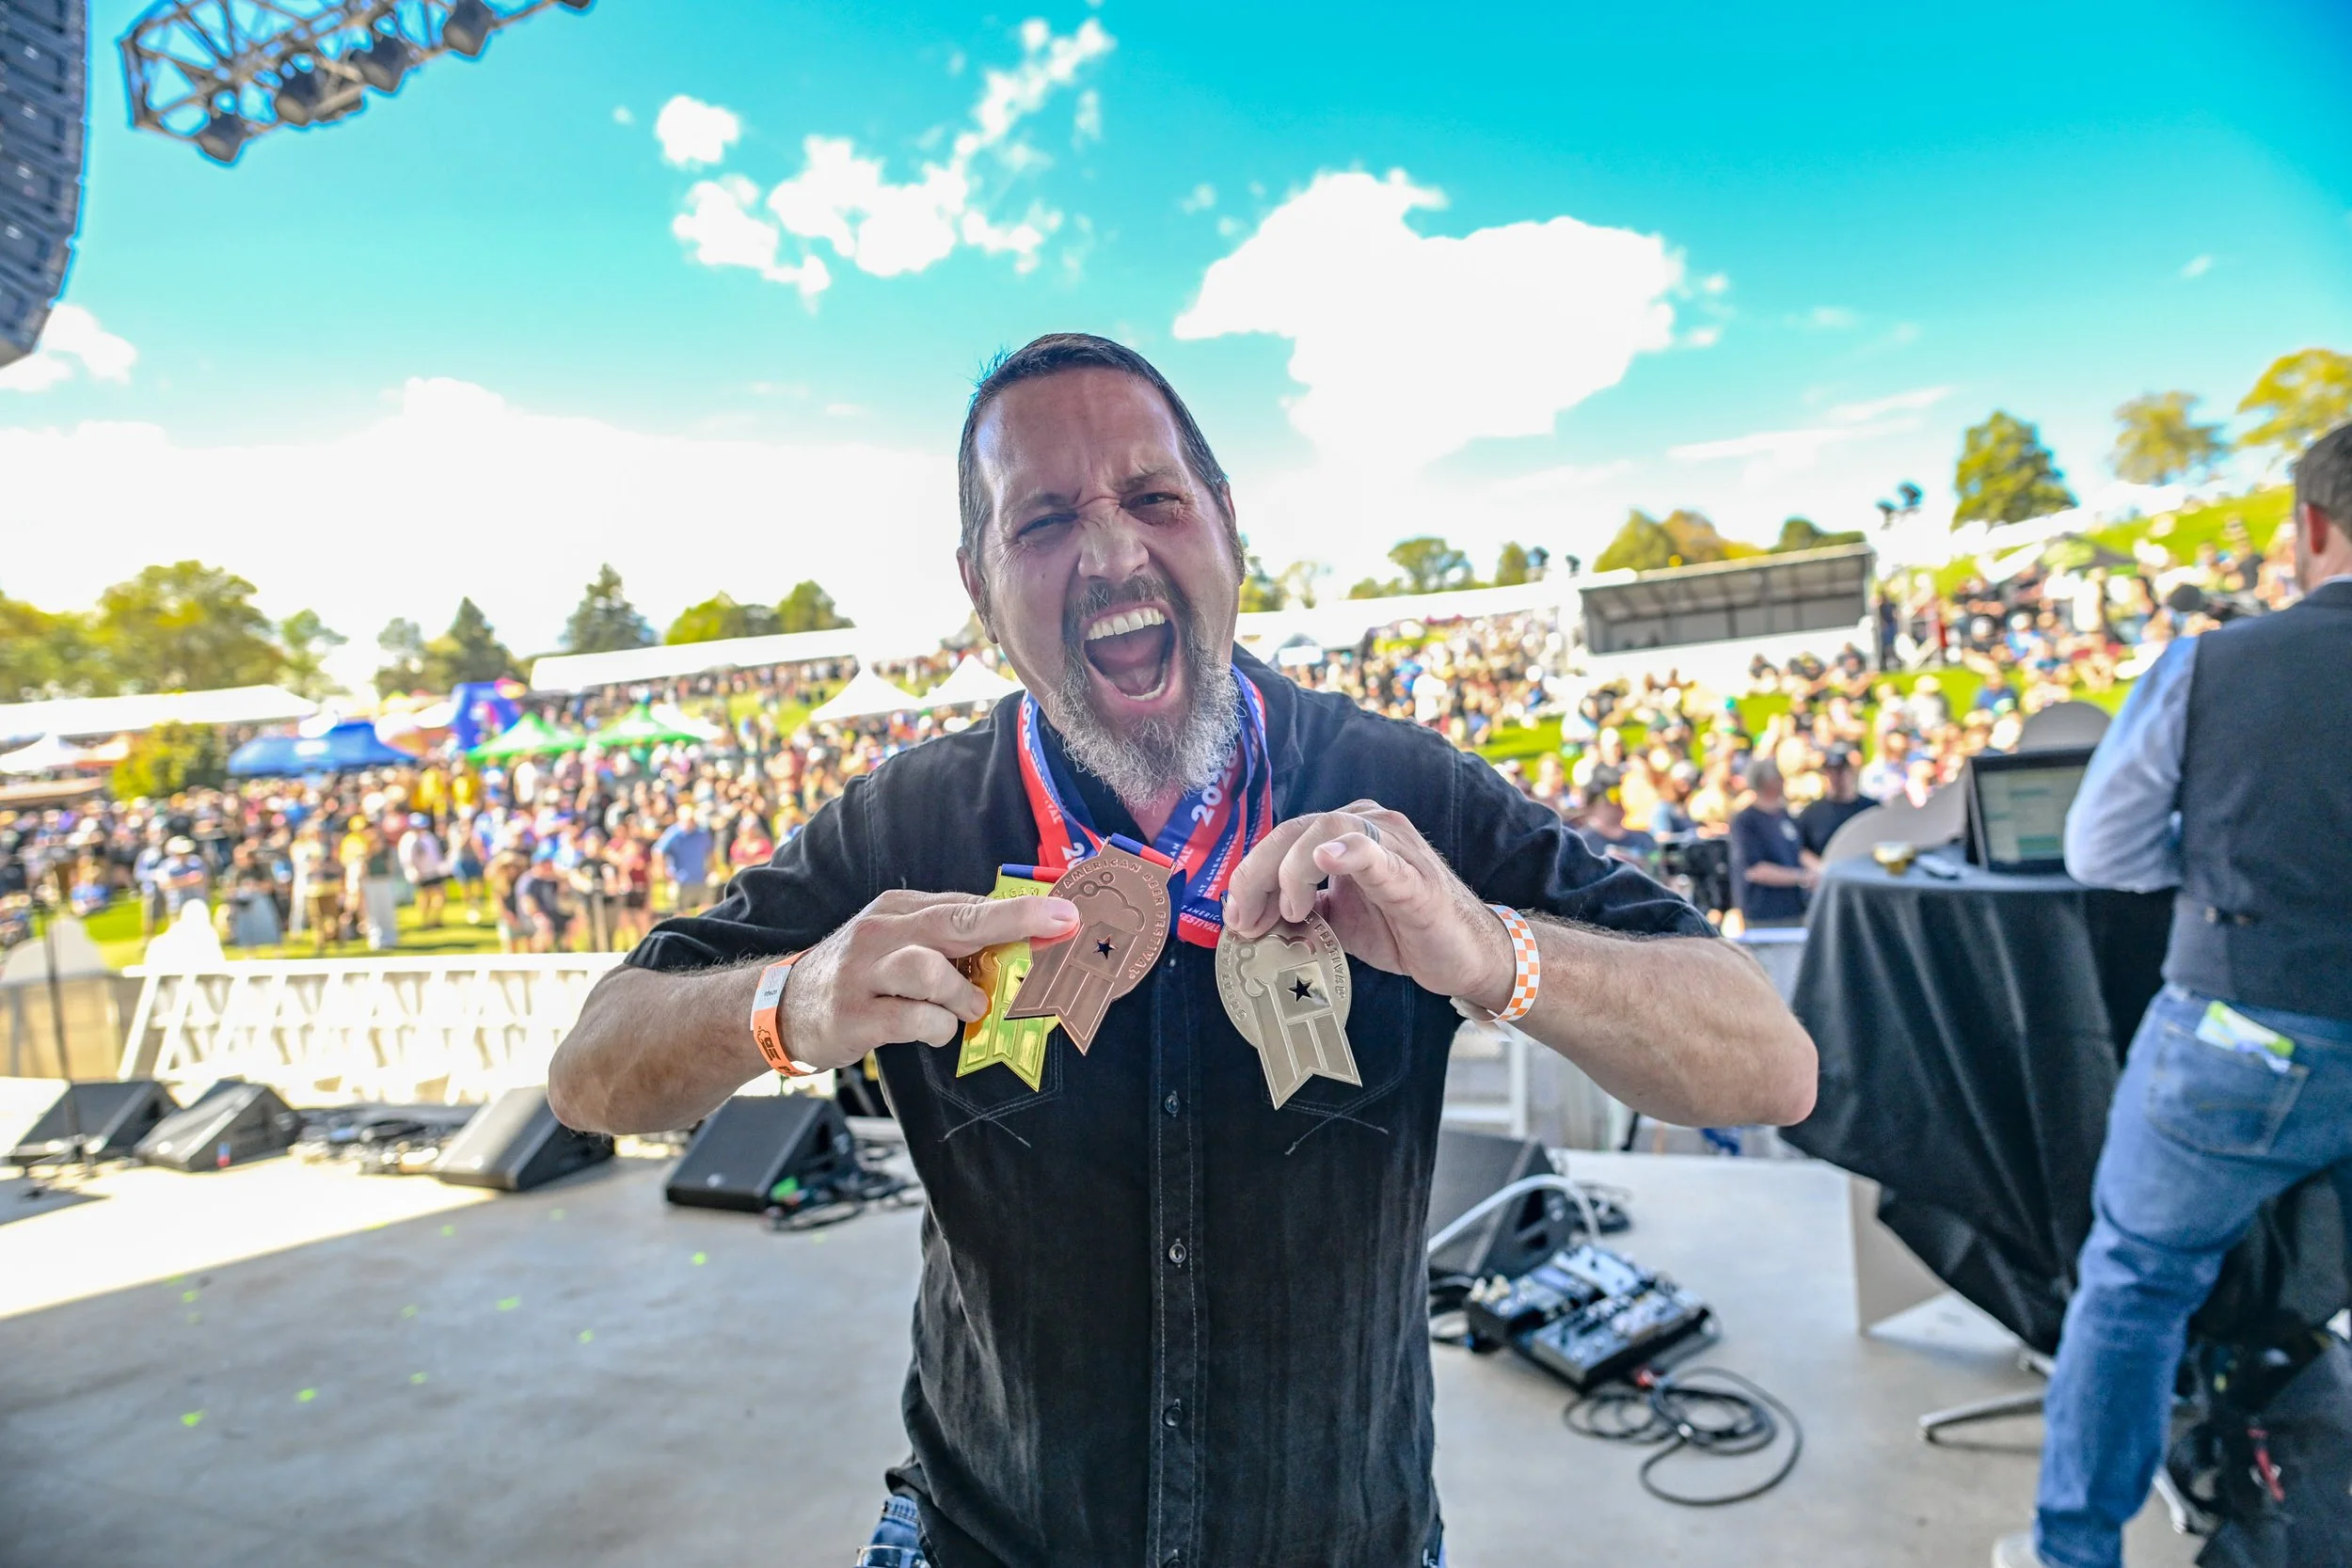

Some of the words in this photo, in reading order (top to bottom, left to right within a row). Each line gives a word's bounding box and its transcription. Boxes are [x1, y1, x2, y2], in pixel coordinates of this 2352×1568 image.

[1063, 858, 1142, 890] AMERICAN
[1142, 873, 1167, 907] BEER
[1196, 883, 1207, 897] AT
